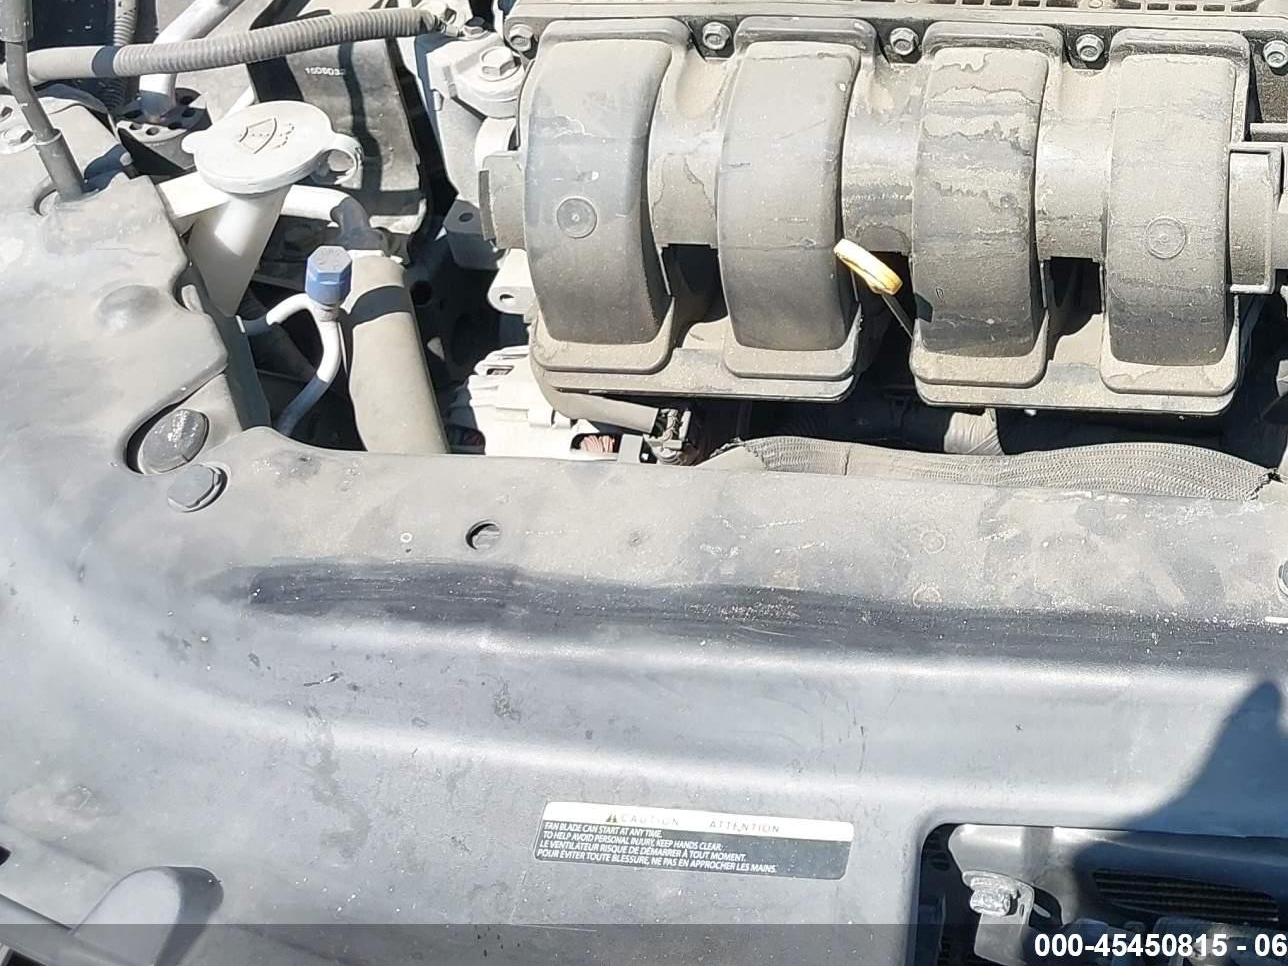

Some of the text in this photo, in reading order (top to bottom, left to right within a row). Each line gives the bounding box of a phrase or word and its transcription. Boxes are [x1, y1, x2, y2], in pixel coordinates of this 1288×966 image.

[544, 821, 559, 830] FAN
[559, 822, 582, 832] BLADE
[582, 824, 598, 833] CAN
[599, 825, 619, 835] START
[619, 827, 629, 835] AT
[630, 828, 643, 836] ANY
[621, 814, 780, 833] CAUTION ATTENTION
[543, 830, 554, 839] TO
[554, 831, 571, 840] HELP
[571, 833, 594, 842] AVOID
[594, 834, 630, 845] PERSONAL
[656, 839, 673, 848] KEEP
[673, 841, 699, 850] HANDS
[537, 848, 560, 858] POUR
[560, 848, 587, 859] ÉVITER
[587, 851, 610, 862] TOUTE
[611, 854, 650, 866] BLESSURE,
[651, 858, 663, 866] NE
[663, 858, 679, 867] PAS
[679, 858, 689, 867] EN
[690, 859, 735, 871] APPROCHER
[750, 864, 777, 874] MAINS.
[540, 840, 549, 848] LE
[549, 840, 599, 852] VENTILATEUR
[599, 844, 628, 854] RISQUE
[629, 846, 640, 854] DE
[640, 845, 682, 858] DÉMARRER
[690, 850, 711, 859] TOUT
[710, 852, 747, 862] MOMENT.
